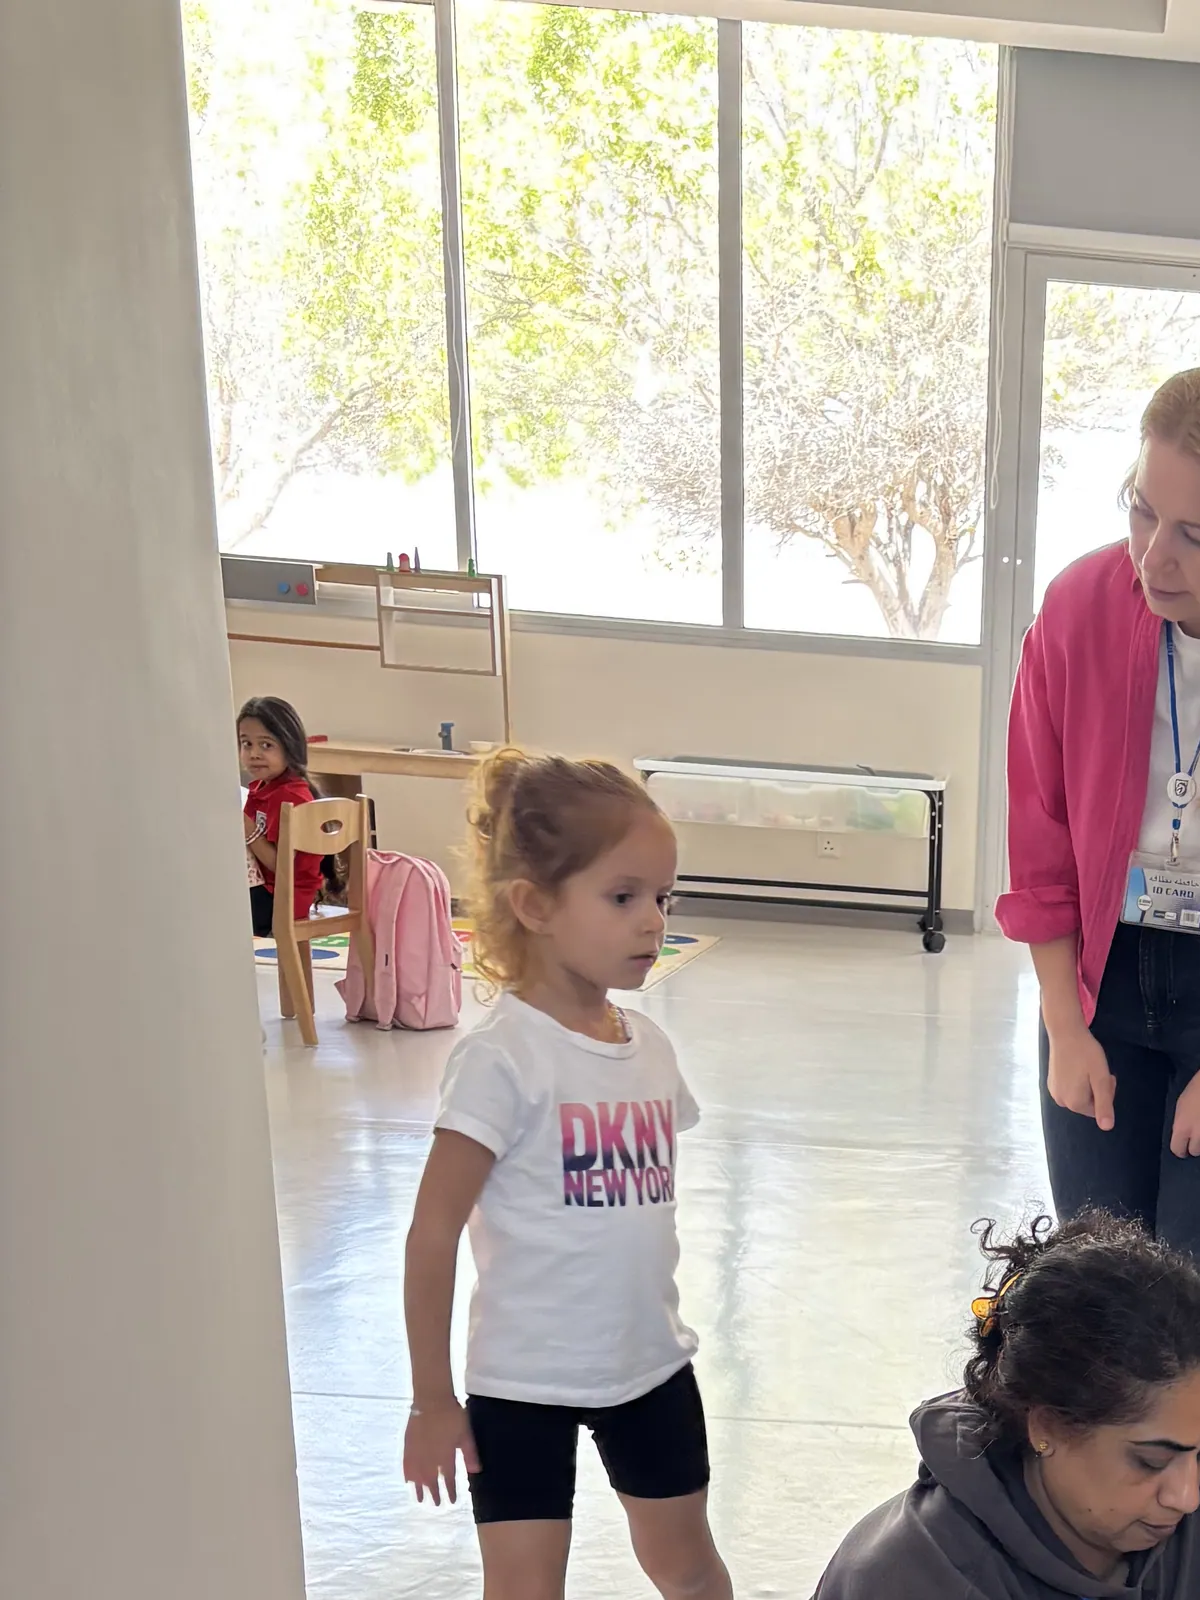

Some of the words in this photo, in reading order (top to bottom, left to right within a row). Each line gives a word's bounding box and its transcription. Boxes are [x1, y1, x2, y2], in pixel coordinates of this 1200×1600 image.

[1152, 886, 1163, 895] ID
[1165, 888, 1195, 899] CARD
[560, 1100, 673, 1170] DKNY
[564, 1169, 627, 1208] NEW
